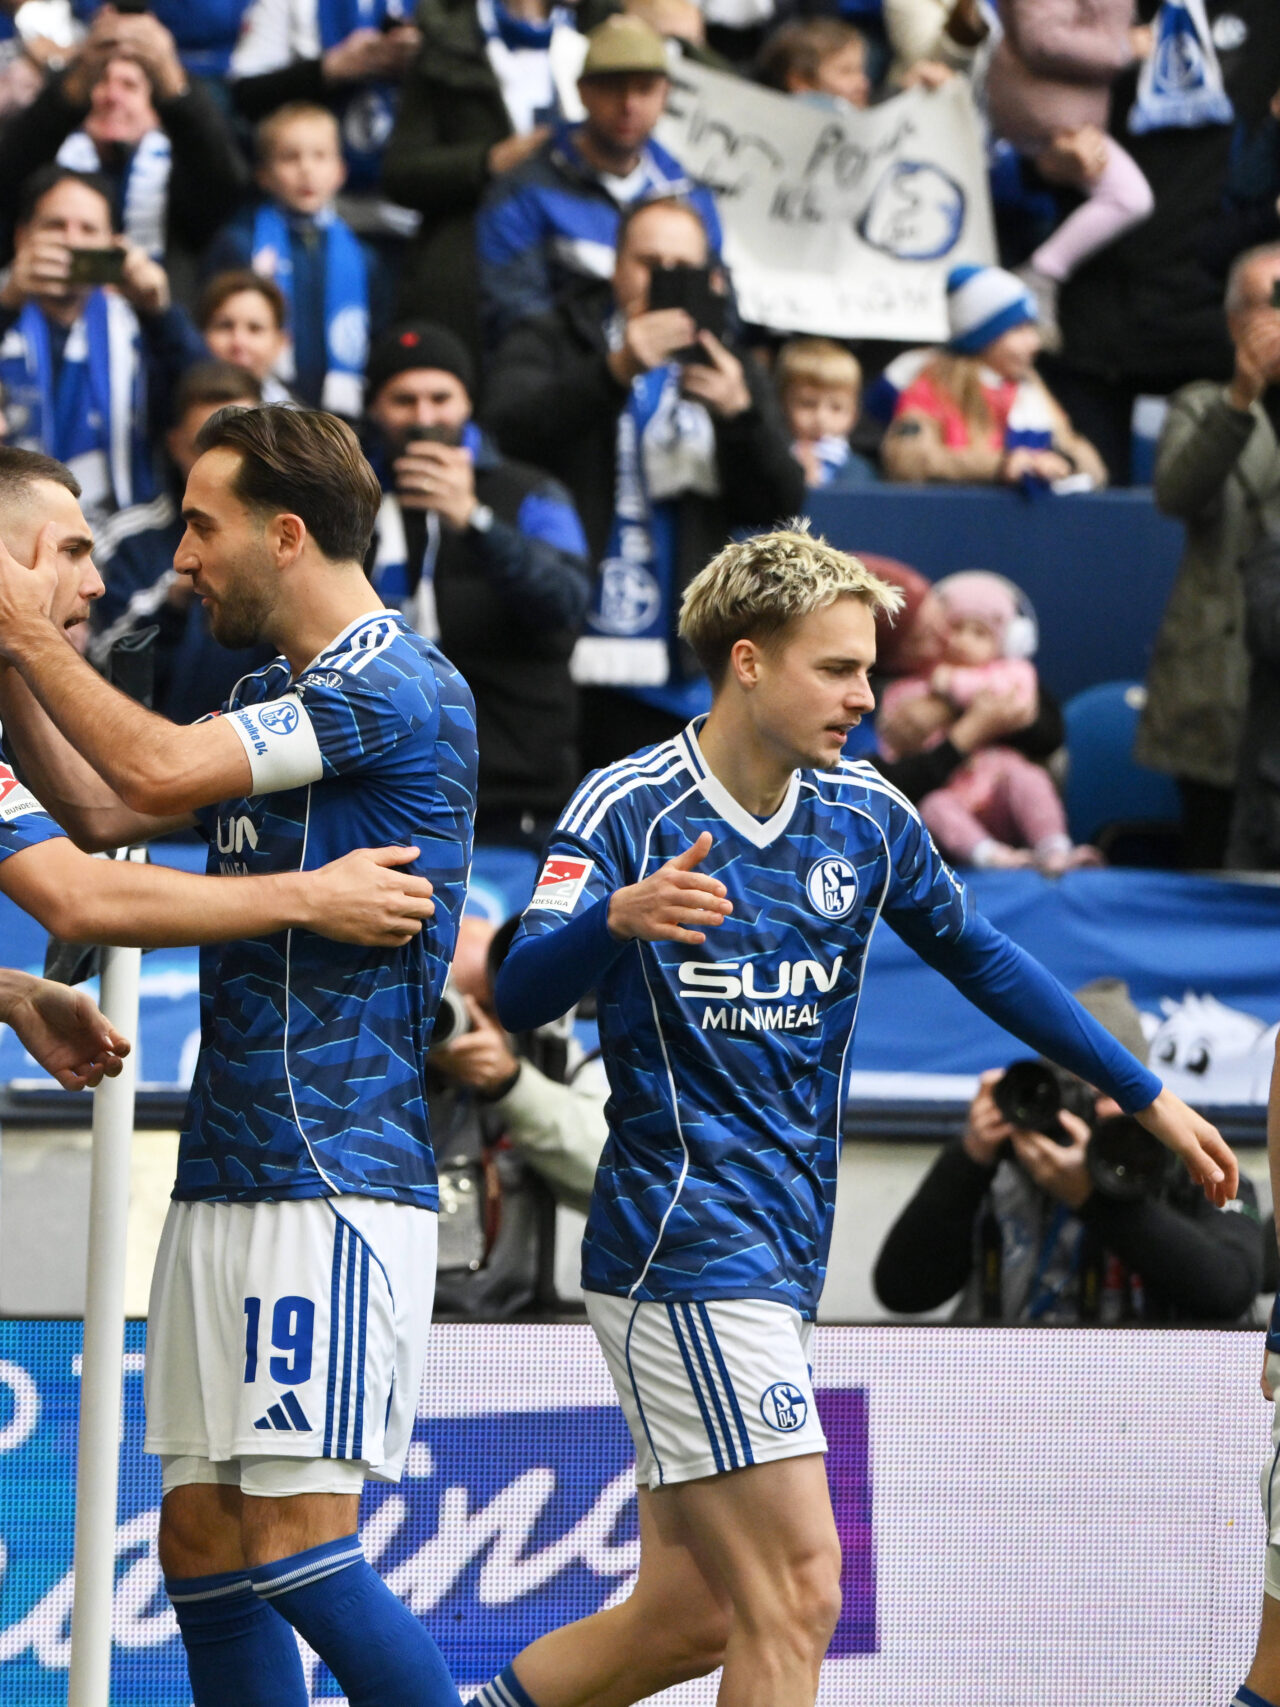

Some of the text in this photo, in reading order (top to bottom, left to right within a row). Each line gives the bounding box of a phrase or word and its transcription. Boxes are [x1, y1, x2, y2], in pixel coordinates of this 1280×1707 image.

[216, 815, 259, 854] UN
[678, 955, 843, 1001] SUN
[243, 1295, 316, 1386] 19
